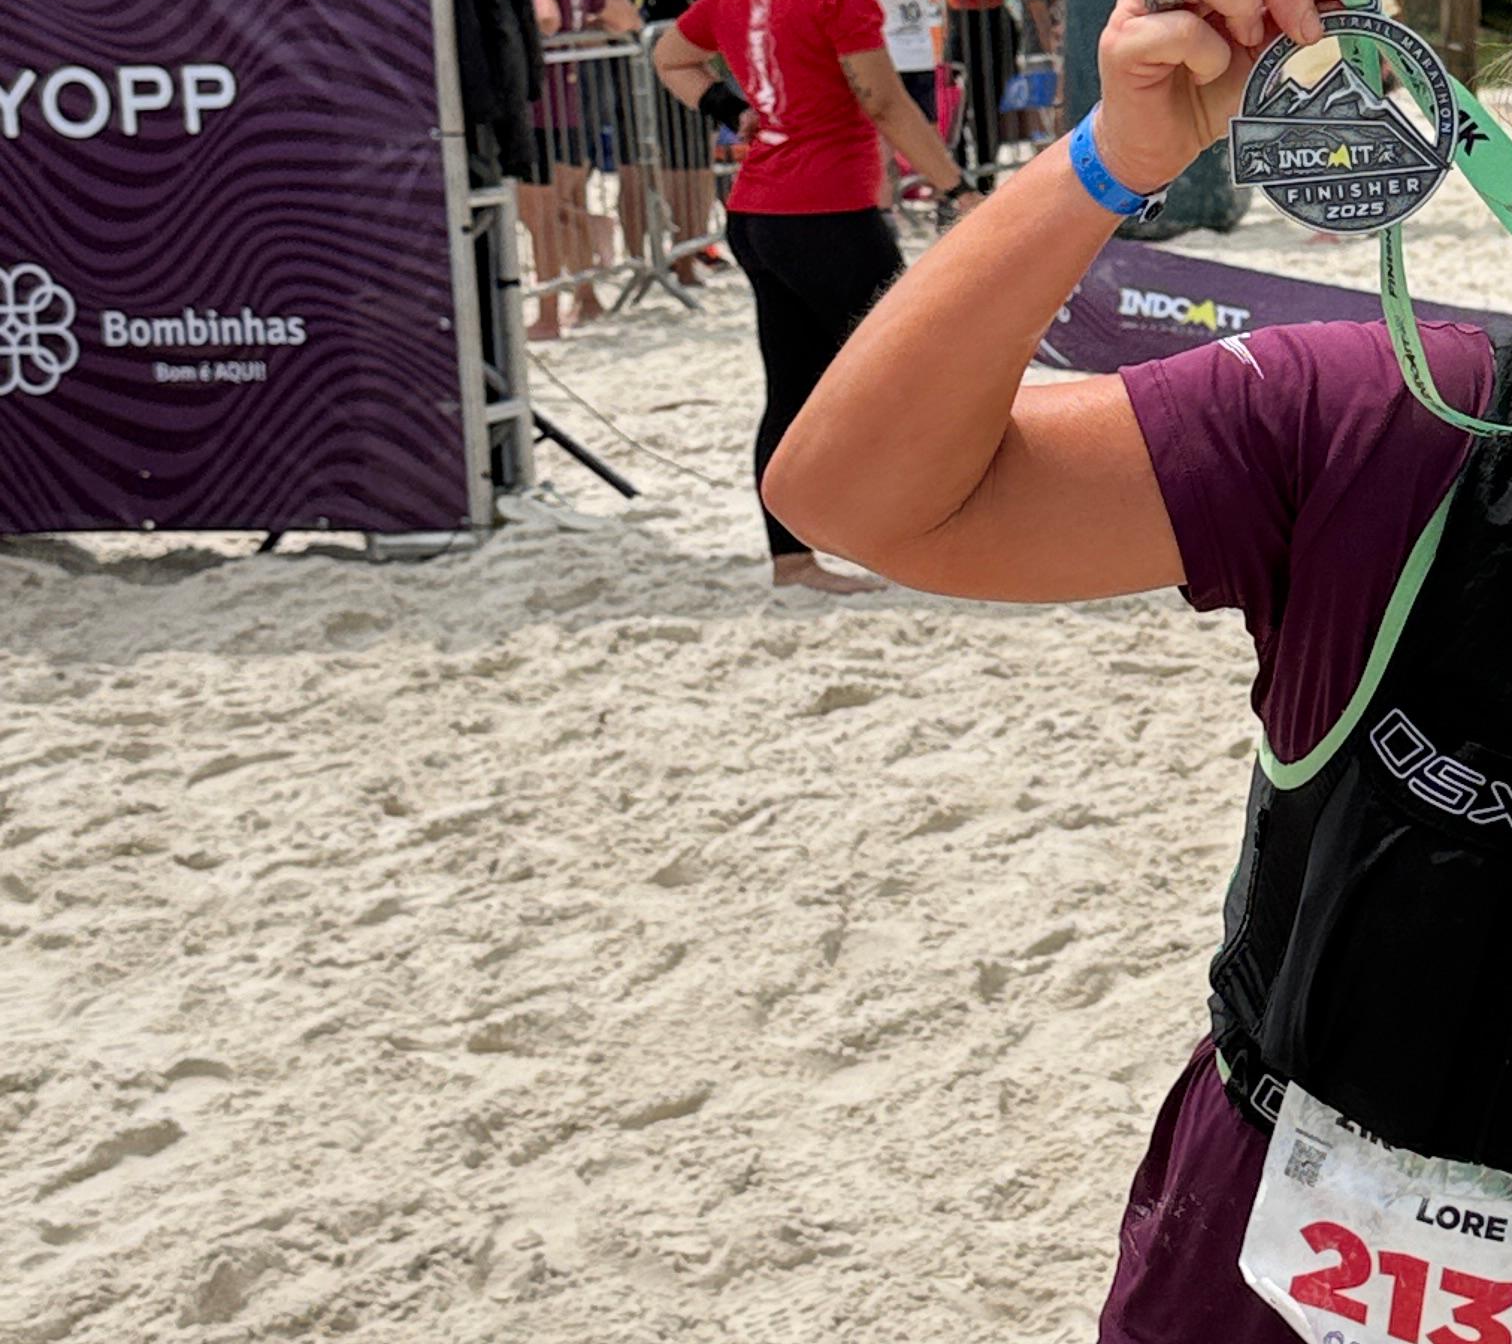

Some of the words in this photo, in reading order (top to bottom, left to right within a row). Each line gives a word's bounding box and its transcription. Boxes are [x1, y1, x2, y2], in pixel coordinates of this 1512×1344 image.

[1339, 16, 1392, 37] TRAIL
[1400, 34, 1453, 135] MARATHON
[0, 64, 237, 139] YOPP
[1287, 177, 1422, 204] FINISHER
[1325, 201, 1385, 220] 2025
[102, 306, 307, 347] Bombinhas
[154, 361, 196, 383] Bom
[1416, 1197, 1509, 1243] LORE
